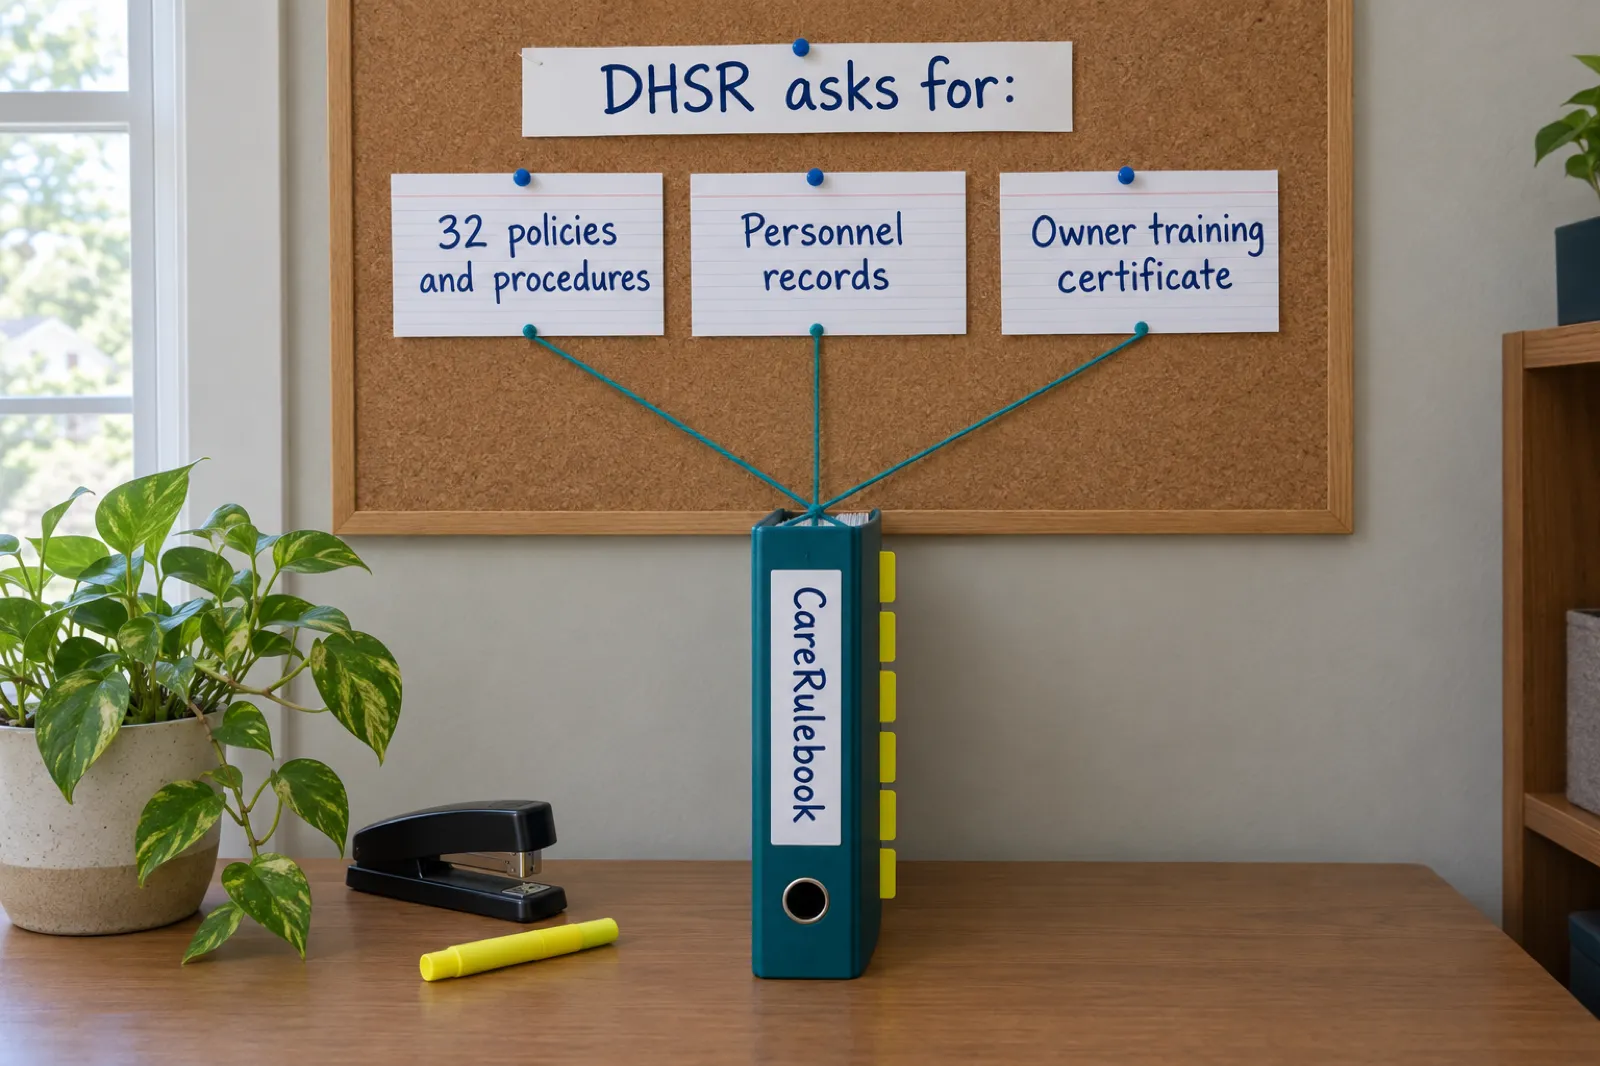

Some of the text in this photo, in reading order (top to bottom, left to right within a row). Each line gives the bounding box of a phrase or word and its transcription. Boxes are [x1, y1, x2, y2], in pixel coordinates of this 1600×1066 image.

[600, 55, 1014, 115] DHSR asks for:
[438, 211, 617, 258] 32 policies
[741, 210, 903, 249] Personnel
[1031, 212, 1265, 257] Owner training
[419, 259, 651, 305] and procedures
[763, 257, 890, 292] records
[1058, 257, 1233, 294] certificate
[792, 586, 827, 824] CareRulebook
